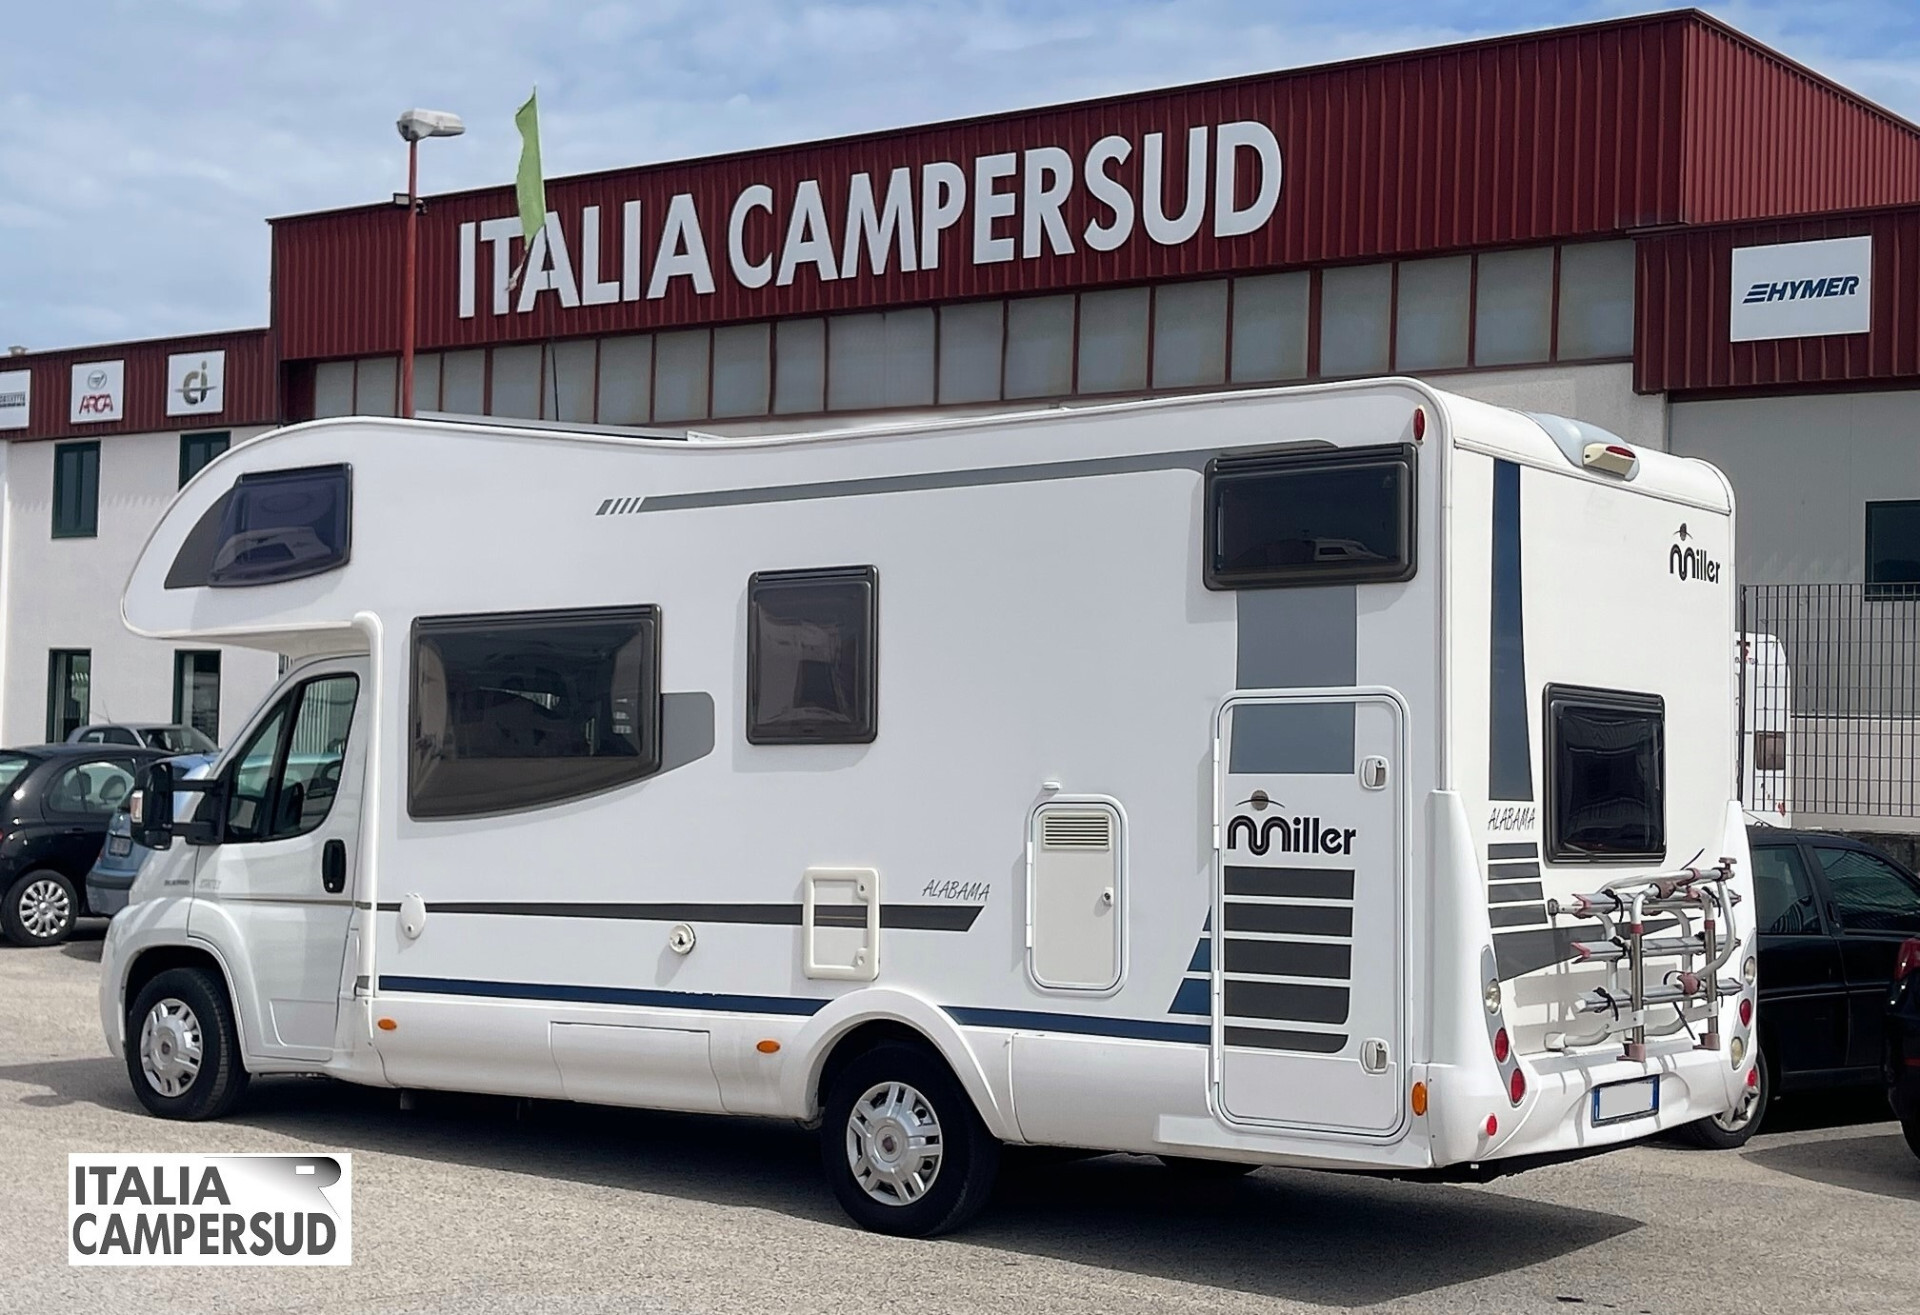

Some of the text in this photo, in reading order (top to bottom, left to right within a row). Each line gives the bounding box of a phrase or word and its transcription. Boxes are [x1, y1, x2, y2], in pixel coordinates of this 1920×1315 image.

[458, 120, 1283, 320] ITALIA CAMPERSUD
[1766, 275, 1860, 303] HYMER
[79, 393, 114, 415] ARCA
[1669, 542, 1721, 585] Miller
[1487, 806, 1536, 831] ALABAMA
[1227, 813, 1357, 857] Miller
[921, 878, 992, 902] ALABAMA
